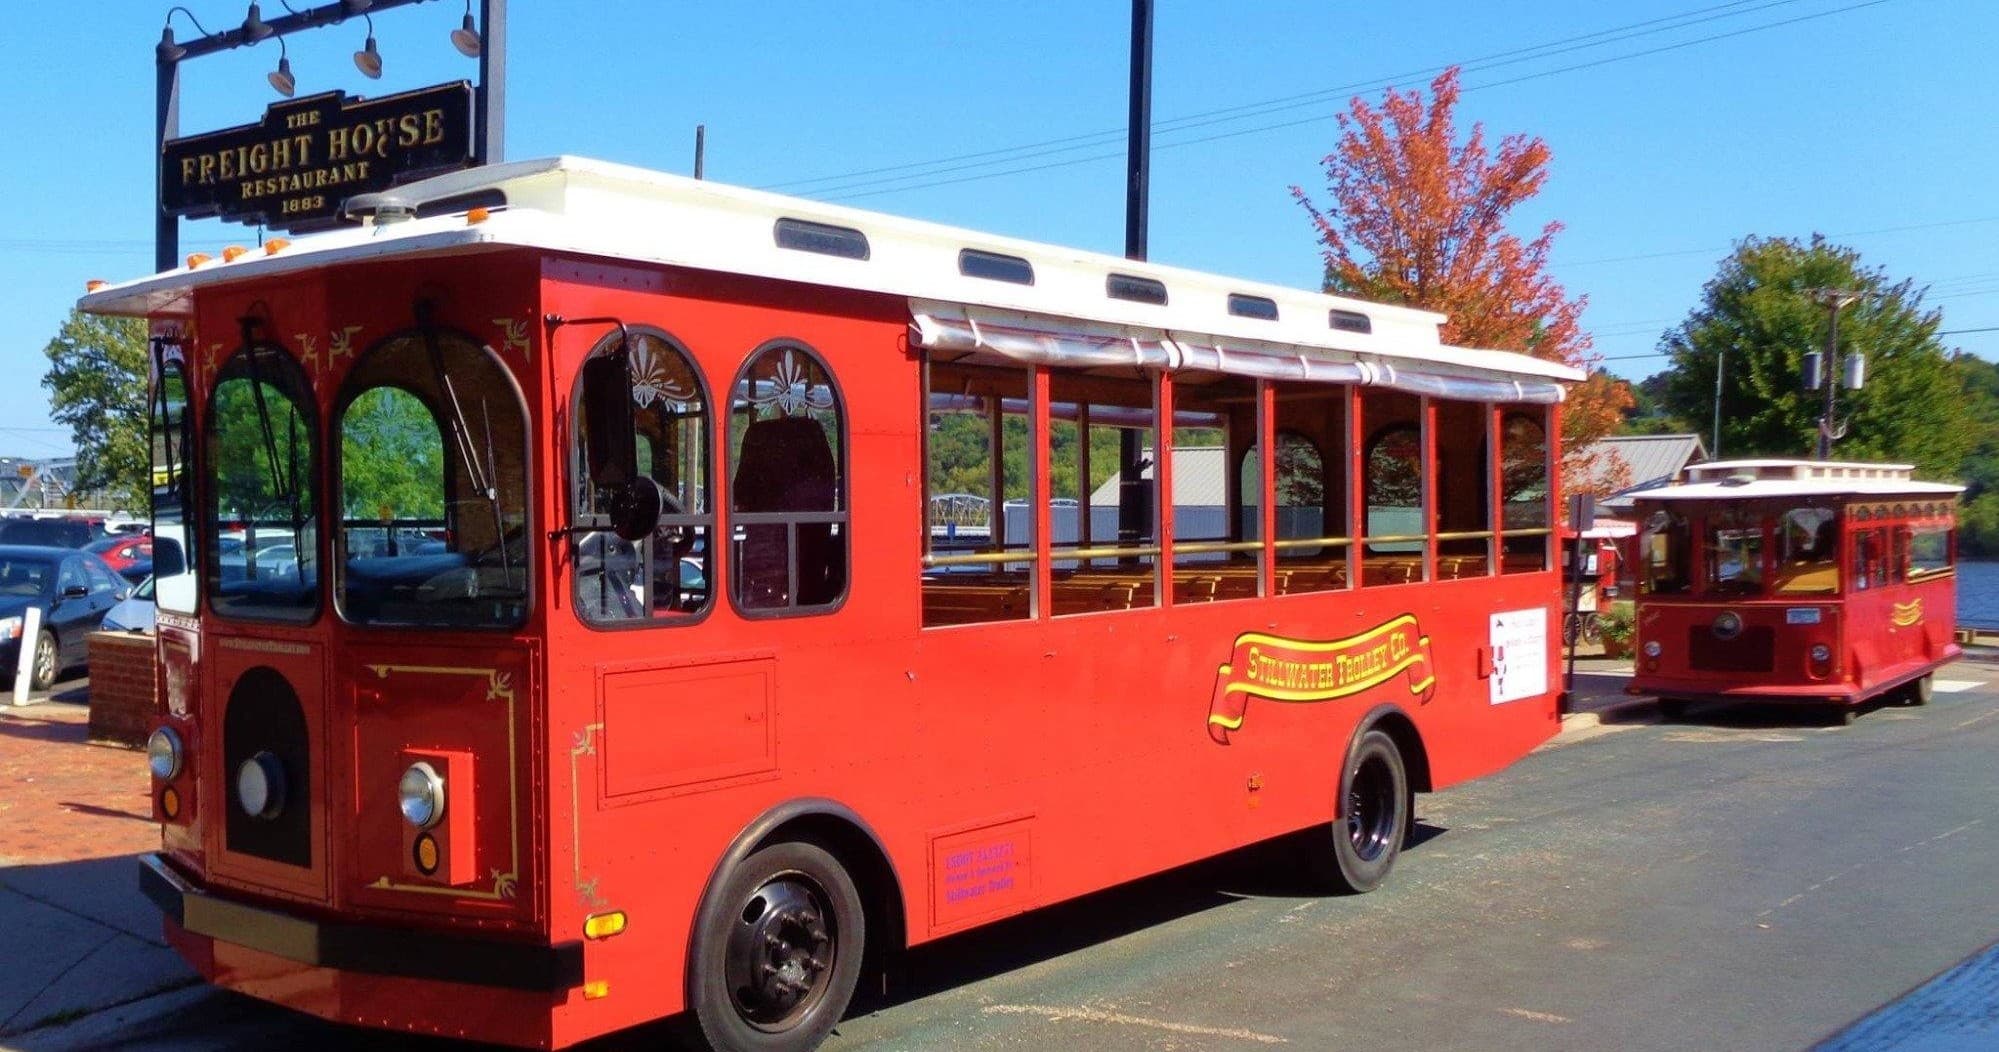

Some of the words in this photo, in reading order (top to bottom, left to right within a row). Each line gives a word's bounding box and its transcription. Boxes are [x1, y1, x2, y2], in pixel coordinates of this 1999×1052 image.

[287, 111, 320, 128] THE
[181, 135, 313, 184] FREIGHT
[329, 109, 445, 160] HOUSE
[241, 160, 370, 200] RESTAURANT
[282, 196, 325, 214] 1883
[1247, 646, 1334, 689] STILLWATER
[1336, 644, 1388, 686] TROLLEY
